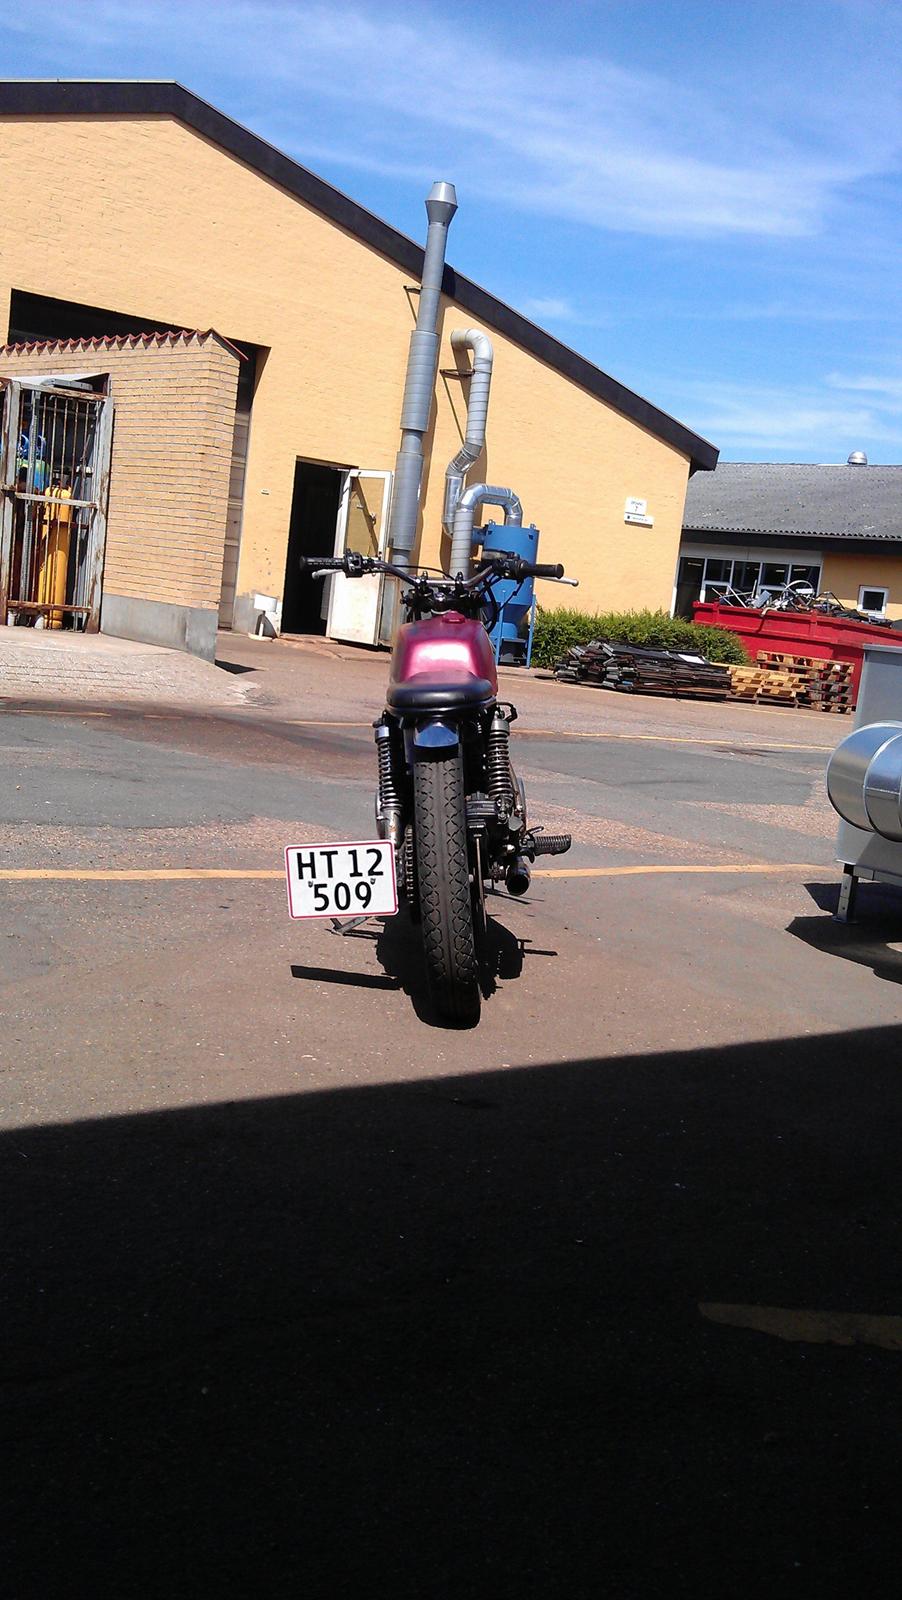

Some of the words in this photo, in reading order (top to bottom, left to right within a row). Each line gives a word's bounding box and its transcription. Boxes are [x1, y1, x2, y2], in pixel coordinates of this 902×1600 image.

[297, 851, 338, 879] HT
[348, 848, 384, 877] 12
[314, 881, 372, 911] 509
